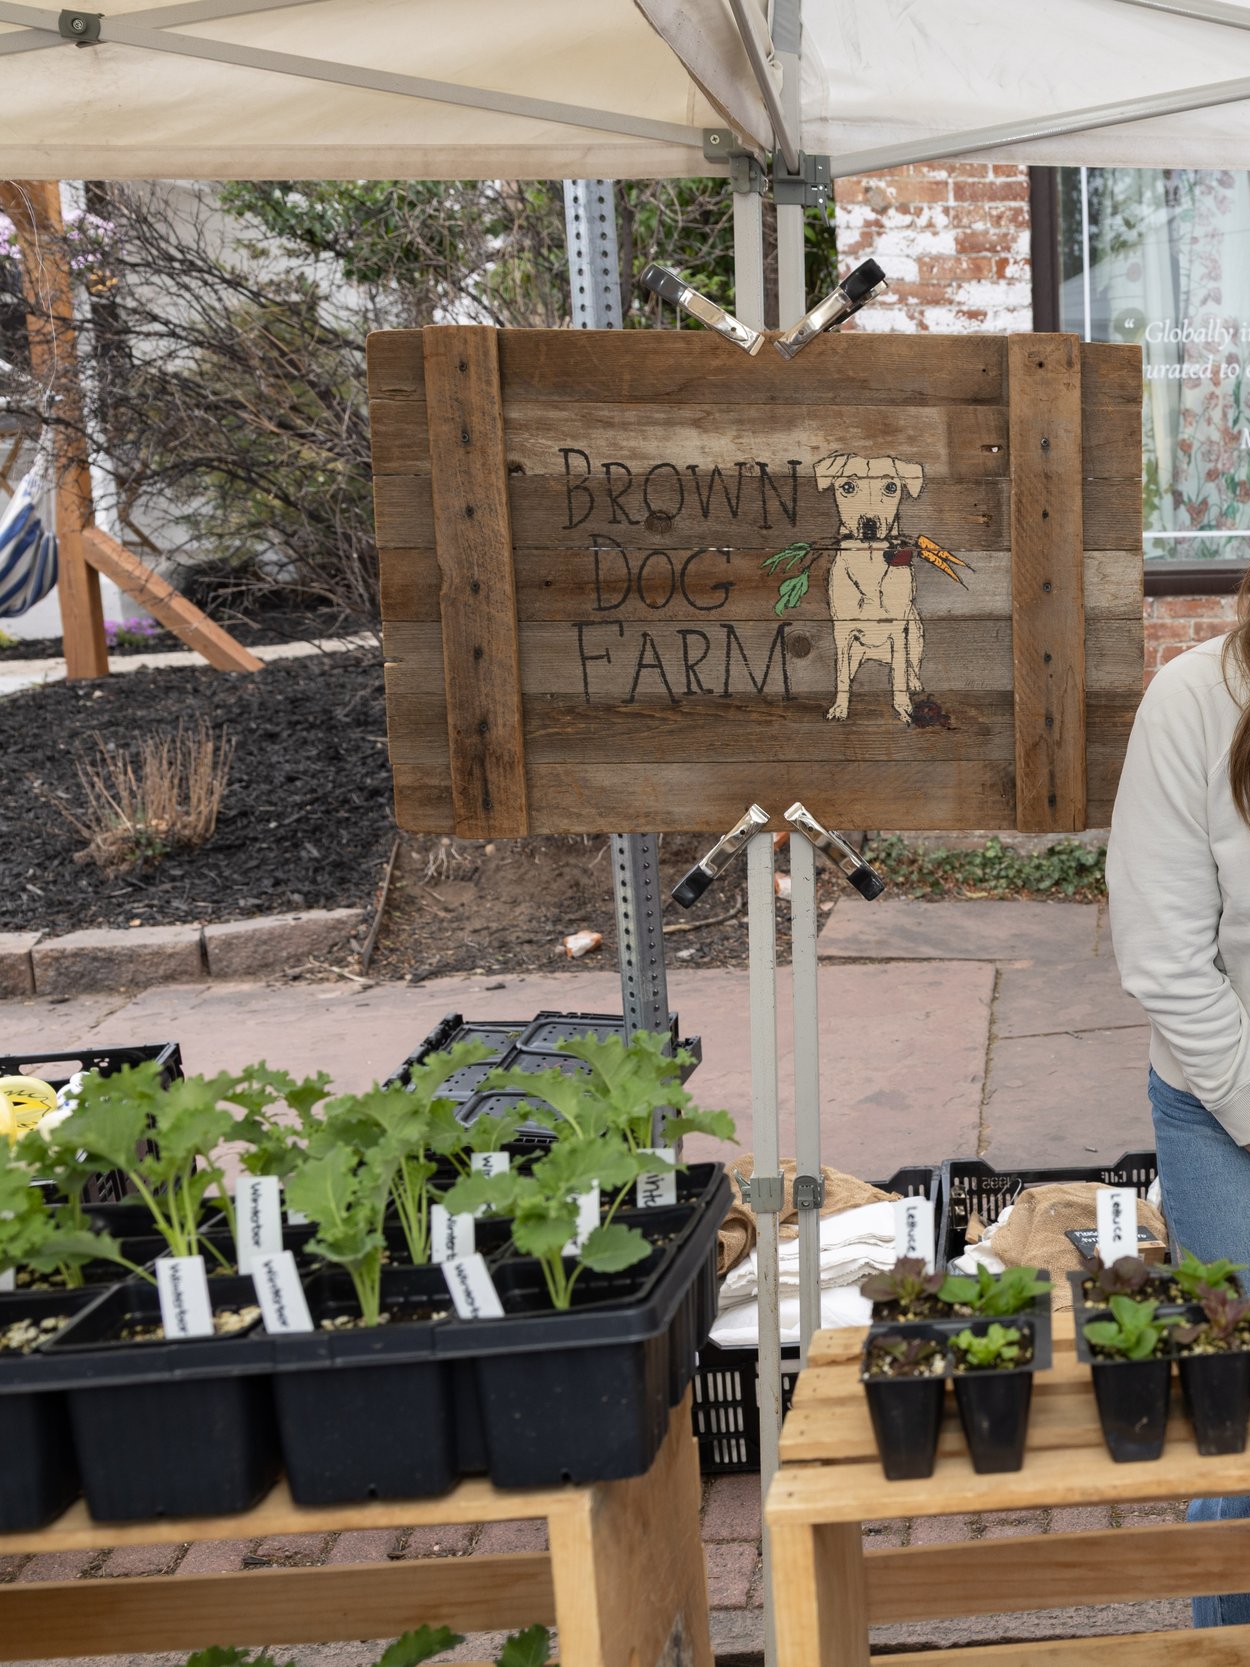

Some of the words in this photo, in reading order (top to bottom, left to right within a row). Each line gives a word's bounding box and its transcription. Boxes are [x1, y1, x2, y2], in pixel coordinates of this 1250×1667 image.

[1144, 319, 1234, 350] Globally
[1145, 354, 1213, 380] urated
[1220, 359, 1240, 379] to
[558, 447, 803, 530] BROWN
[588, 533, 737, 611] DOG
[571, 620, 798, 704] FARM
[905, 1206, 918, 1254] Lettuce
[1110, 1192, 1124, 1243] Lettuce
